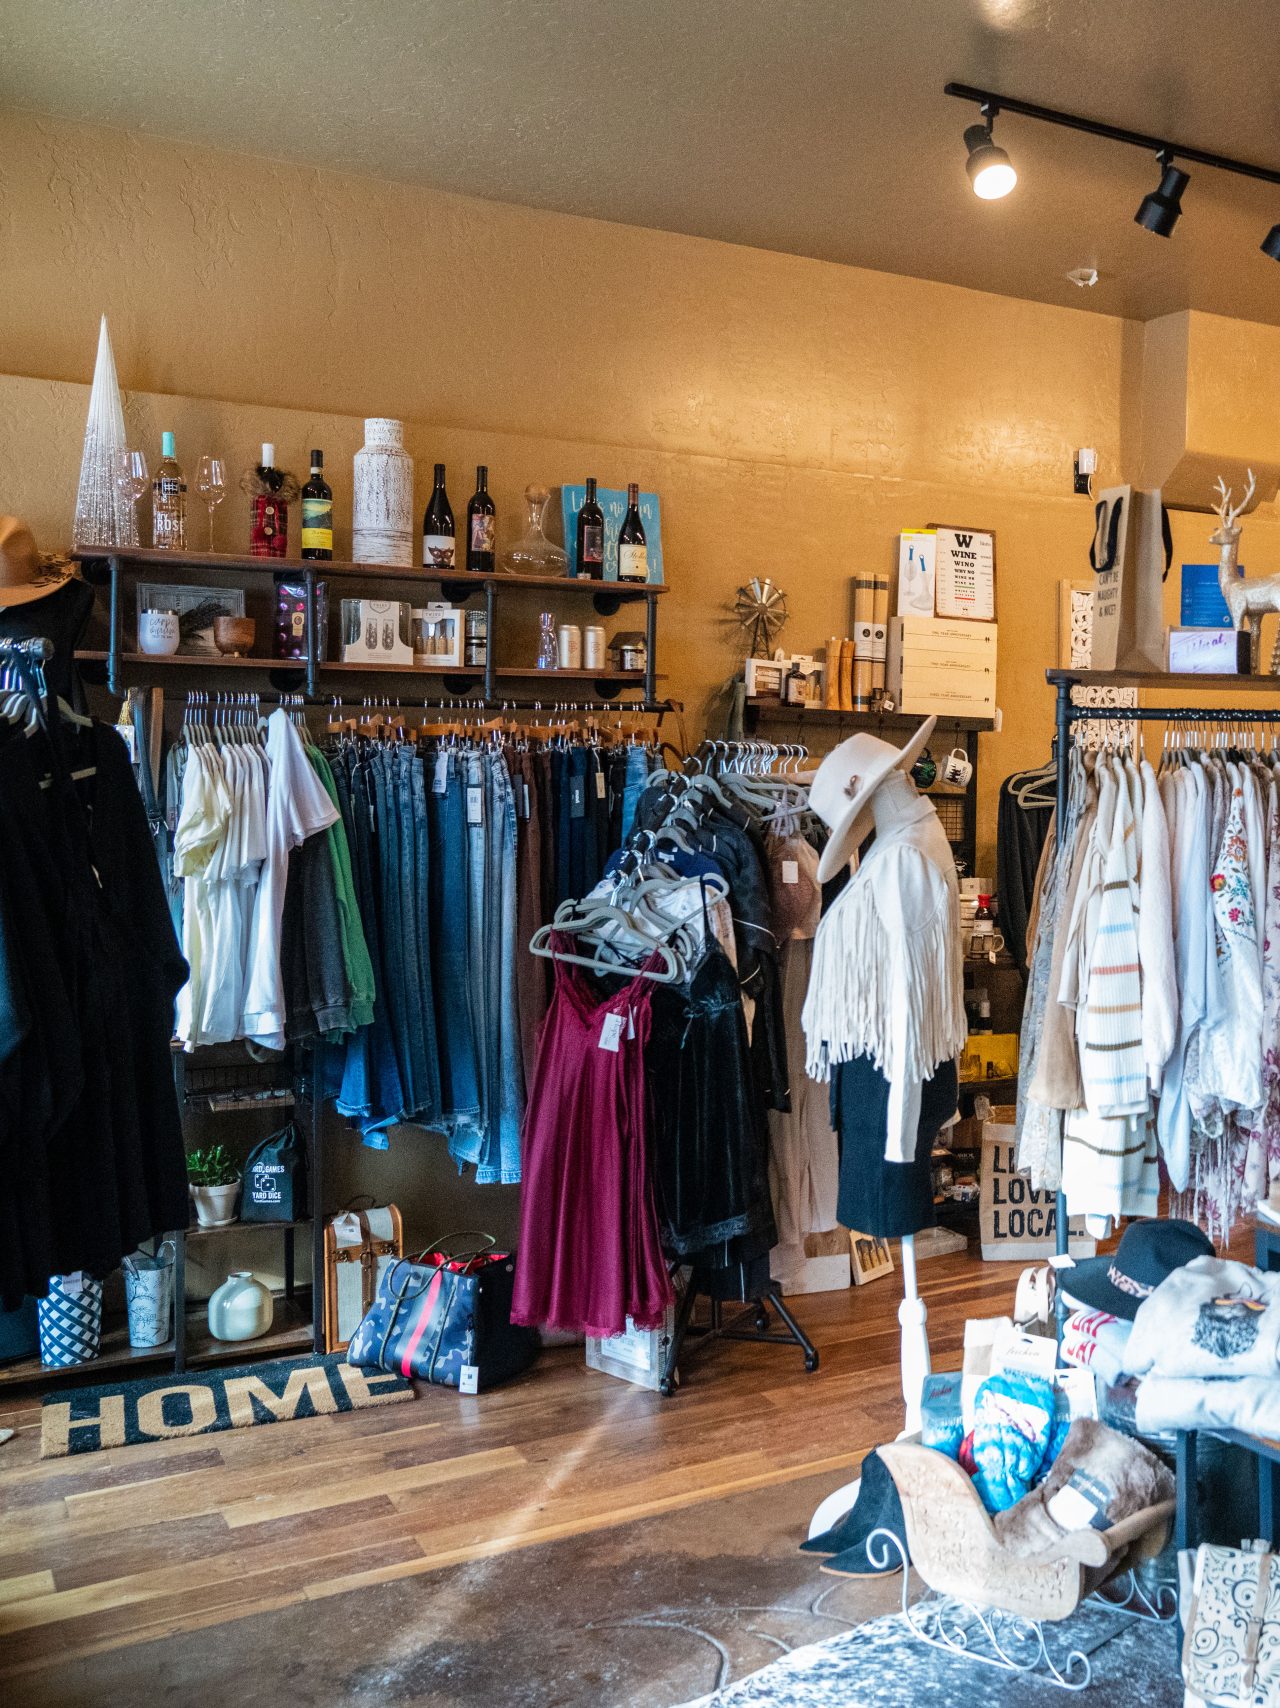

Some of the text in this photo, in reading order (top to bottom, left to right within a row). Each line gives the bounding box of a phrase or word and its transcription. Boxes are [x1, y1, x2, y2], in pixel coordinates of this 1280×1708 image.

[954, 533, 973, 549] W
[950, 549, 977, 560] WINE
[265, 1165, 285, 1173] GAMES
[252, 1191, 282, 1200] YARD DICE
[40, 1363, 415, 1460] HOME
